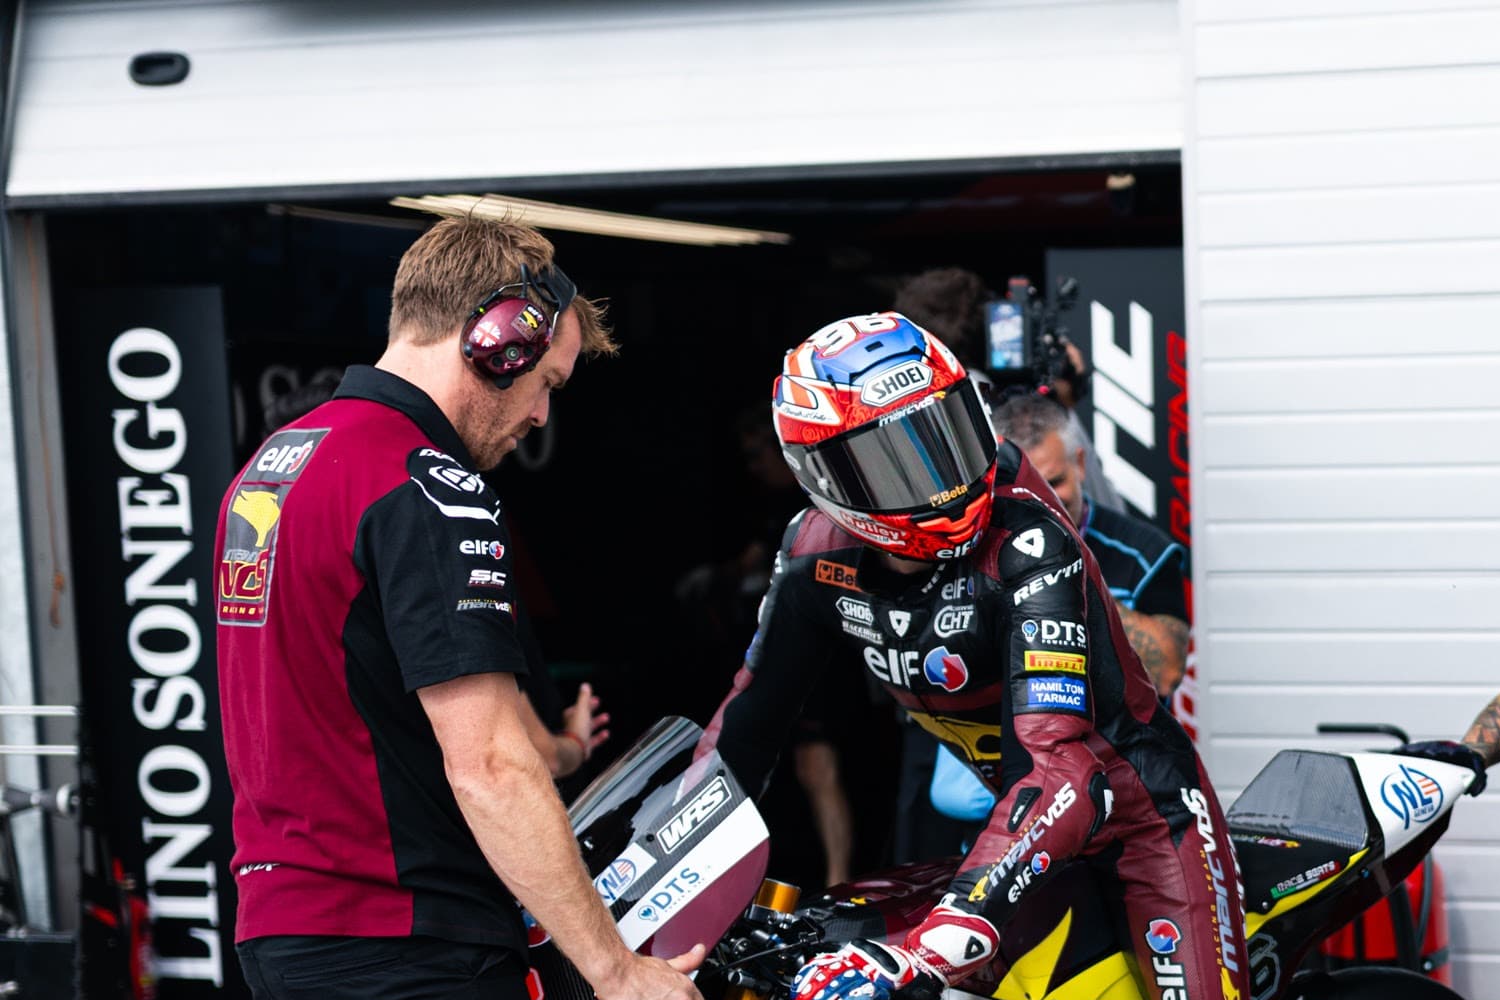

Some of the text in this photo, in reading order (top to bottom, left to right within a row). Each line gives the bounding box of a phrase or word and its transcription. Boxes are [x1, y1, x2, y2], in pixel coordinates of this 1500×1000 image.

[871, 366, 925, 400] SHOEI
[1090, 300, 1156, 518] TIC
[942, 484, 968, 503] Beta
[459, 540, 490, 555] elf
[936, 541, 971, 558] elf
[941, 577, 966, 600] elf
[941, 611, 974, 631] CHT
[1041, 619, 1086, 644] DTS
[108, 327, 224, 988] LINO SONEGO
[864, 646, 920, 688] elf
[1029, 654, 1083, 672] PIRELLI
[1031, 682, 1085, 696] HAMILTON
[1036, 692, 1081, 706] TARMAC
[660, 784, 725, 850] WRS
[651, 866, 700, 910] DTS
[1008, 866, 1033, 903] elf
